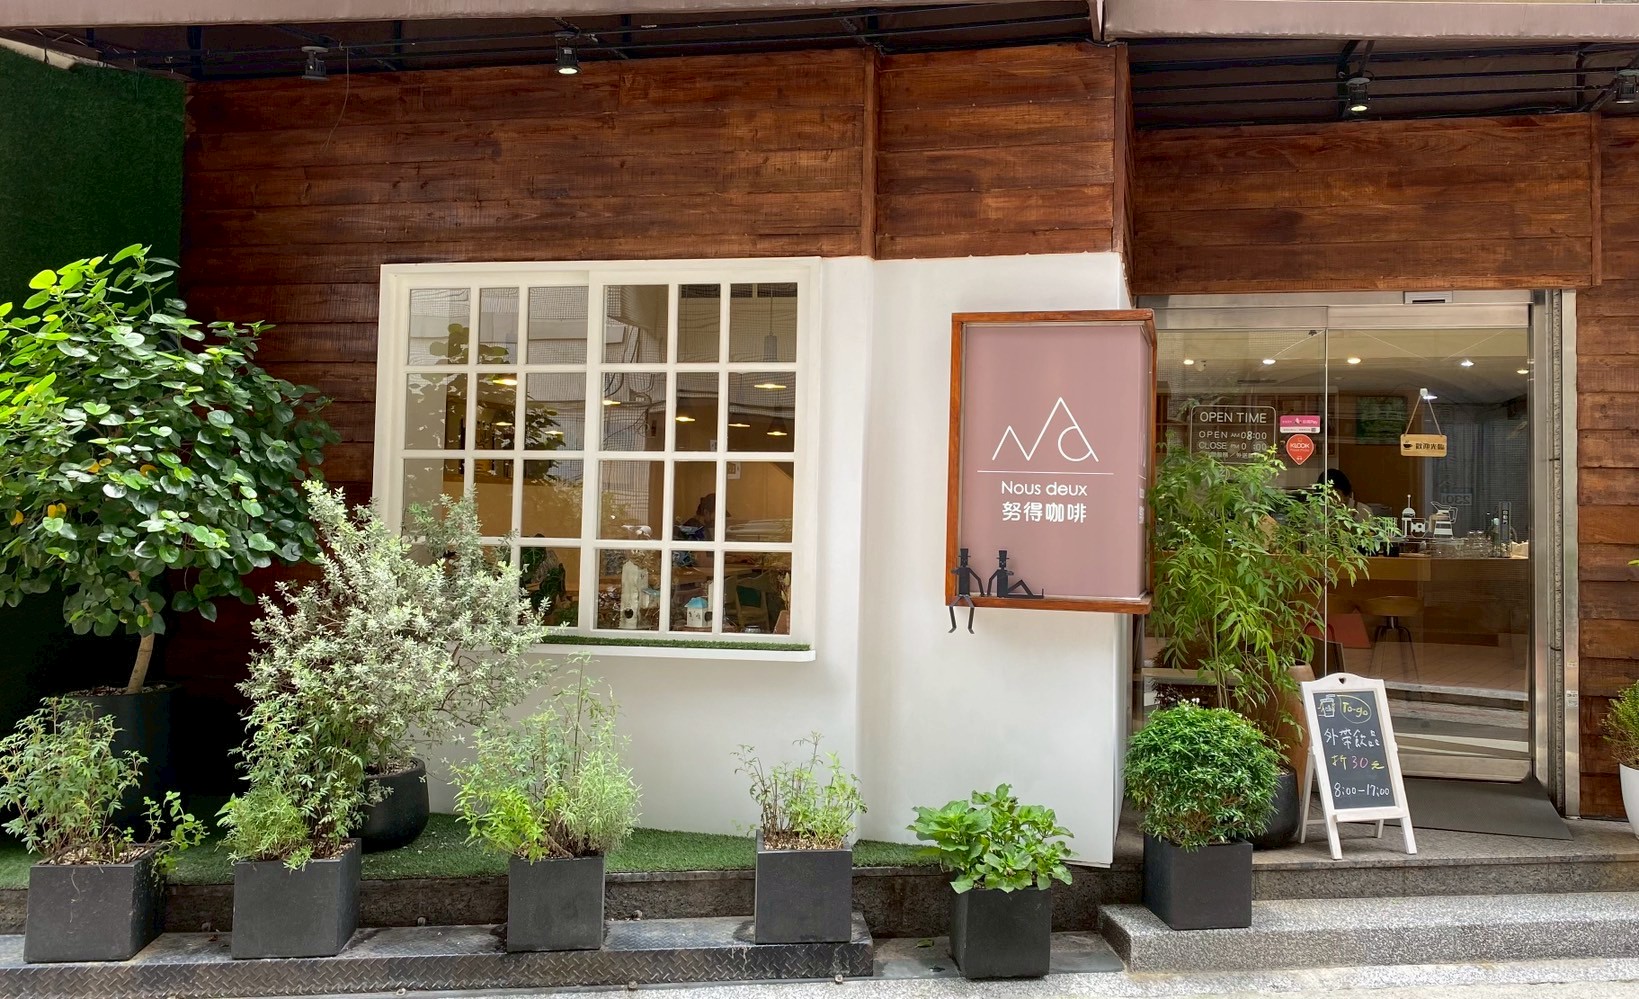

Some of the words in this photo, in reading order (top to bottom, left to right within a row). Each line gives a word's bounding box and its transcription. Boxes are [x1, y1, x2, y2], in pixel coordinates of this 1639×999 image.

[1199, 411, 1233, 423] OPEN
[1237, 412, 1267, 424] TIME
[1241, 431, 1267, 440] 08:00
[1198, 441, 1227, 450] CLOSE
[1001, 481, 1041, 495] Nous
[1046, 482, 1087, 496] deux
[1002, 501, 1087, 523] 努得咖啡
[1342, 701, 1368, 718] To-go
[1324, 728, 1380, 749] 外帶飲品
